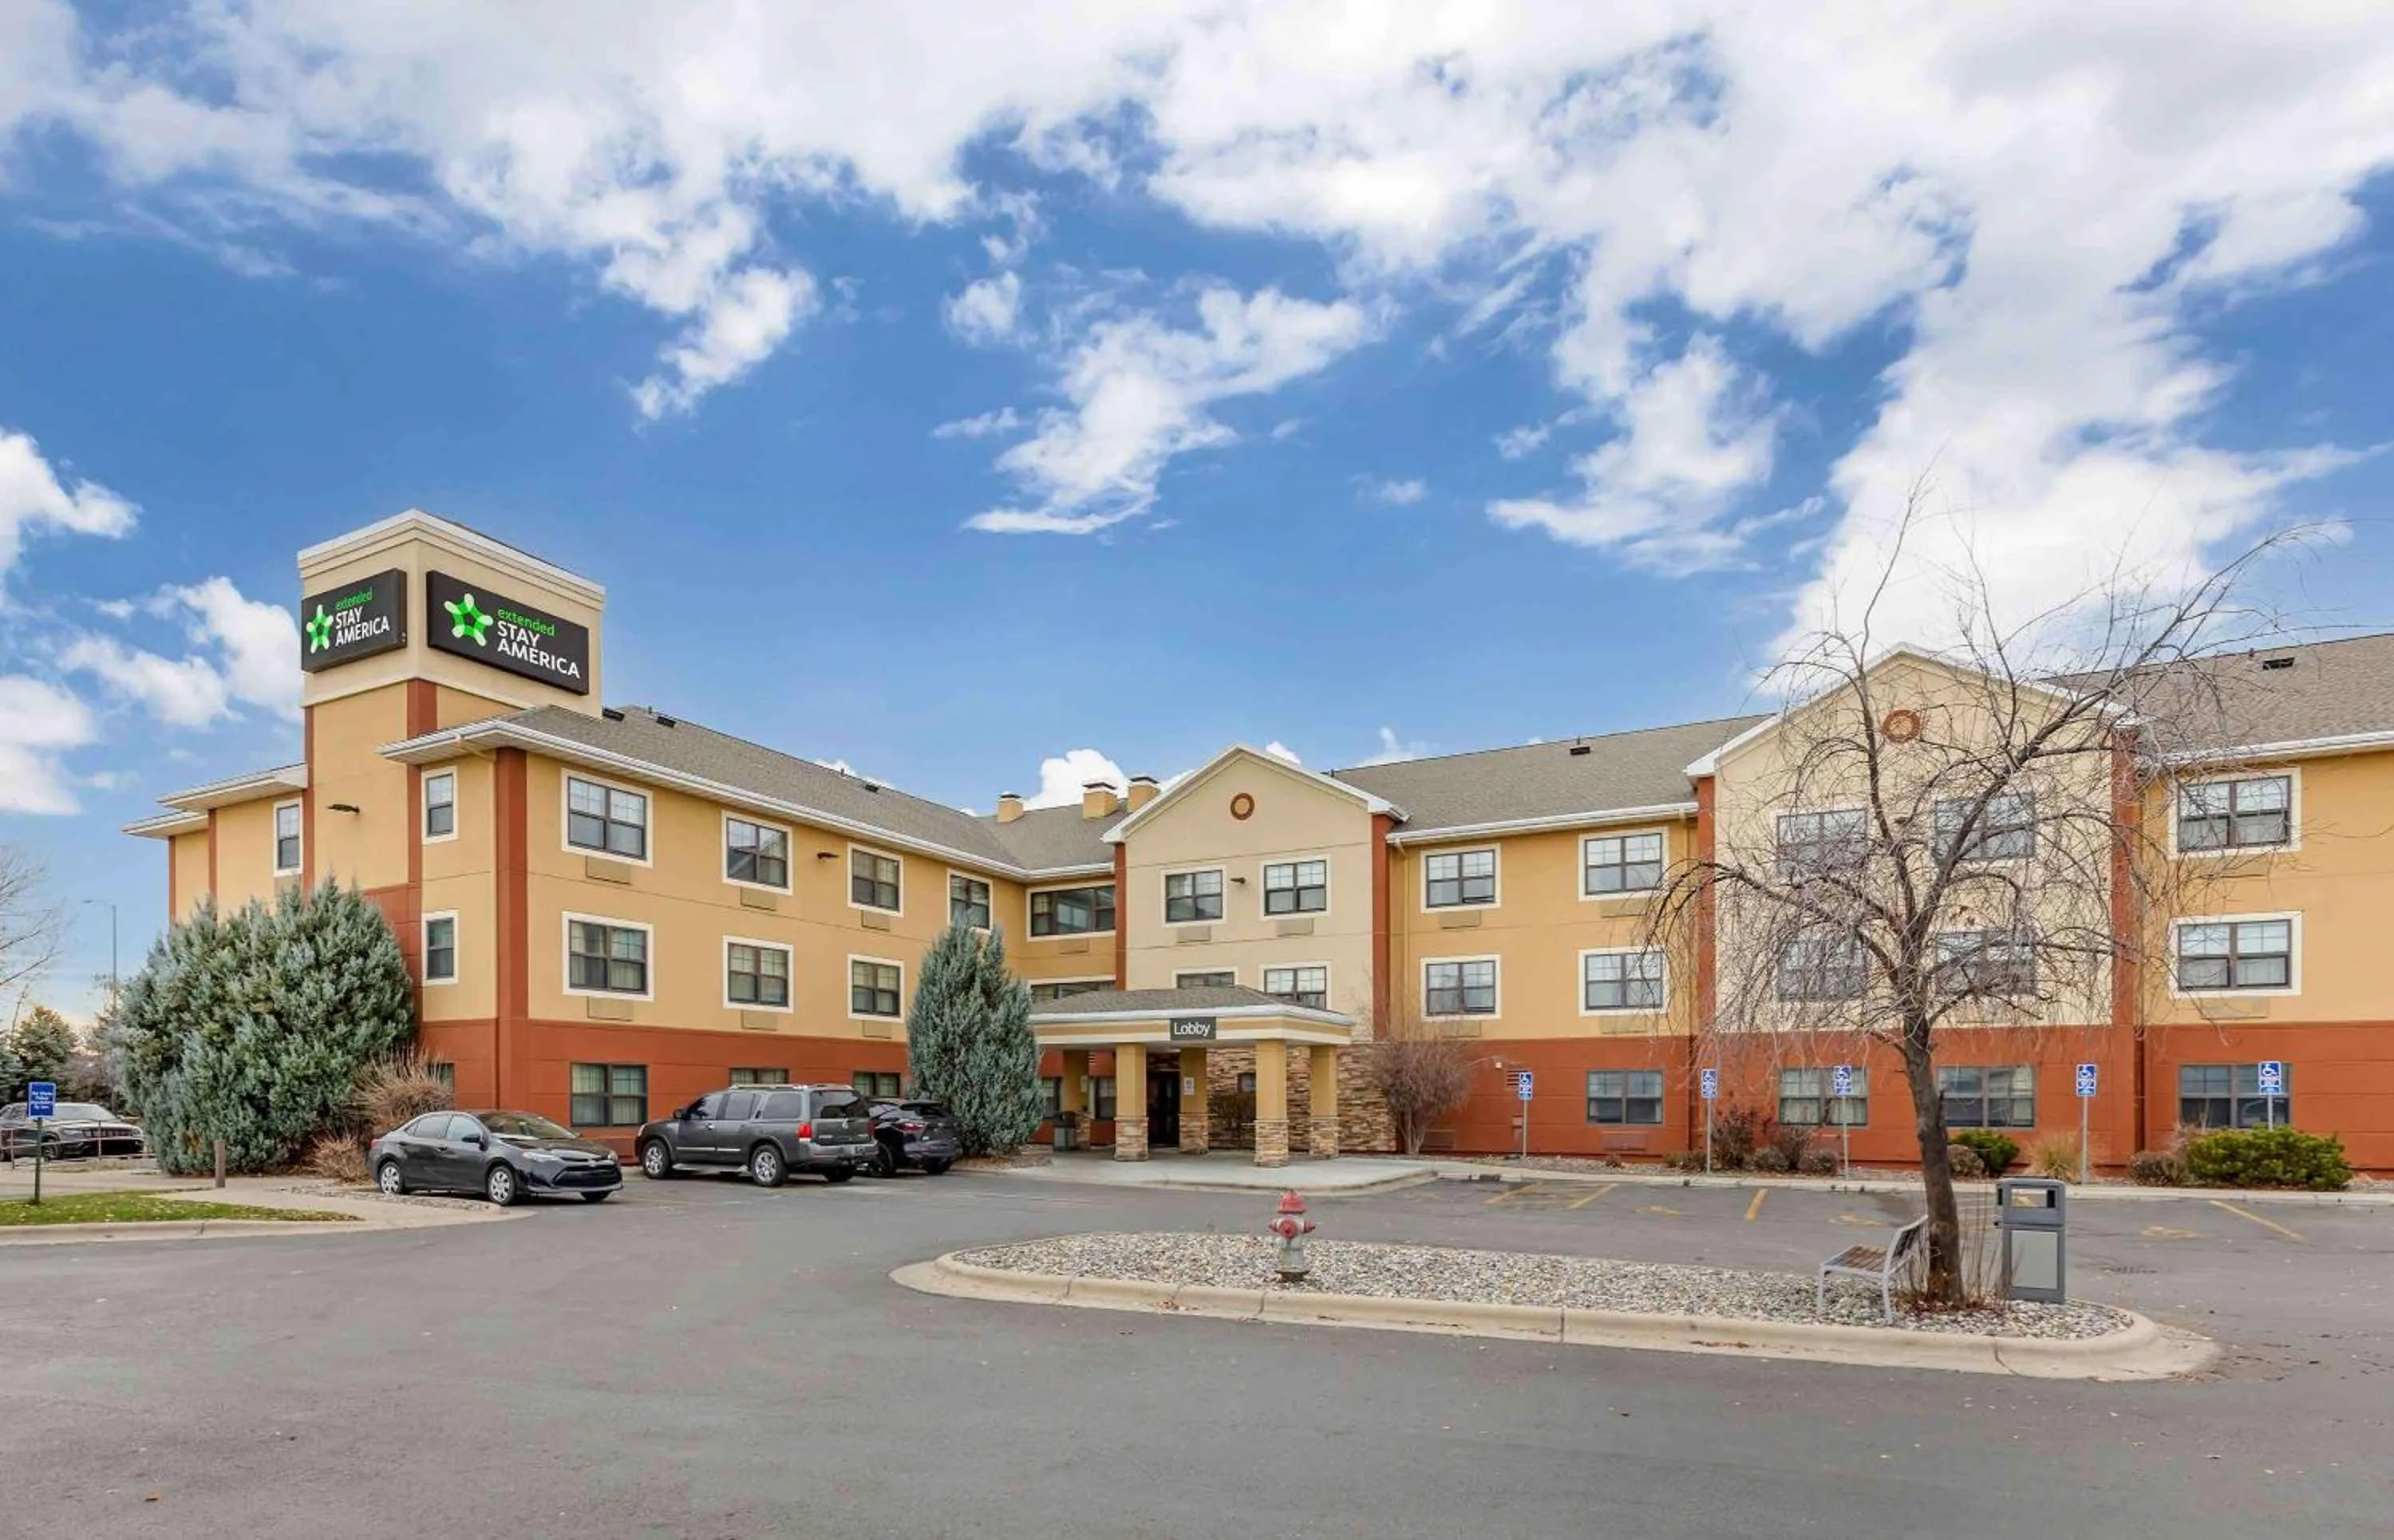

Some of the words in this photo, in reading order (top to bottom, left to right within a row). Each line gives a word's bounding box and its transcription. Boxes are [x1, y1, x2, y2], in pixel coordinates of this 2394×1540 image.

[335, 587, 373, 610] extended
[334, 615, 390, 647] AMERICA
[335, 606, 363, 630] STAY
[497, 609, 555, 636] extended
[497, 620, 540, 647] STAY
[497, 638, 580, 679] AMERICA
[1174, 1022, 1211, 1037] Lobby
